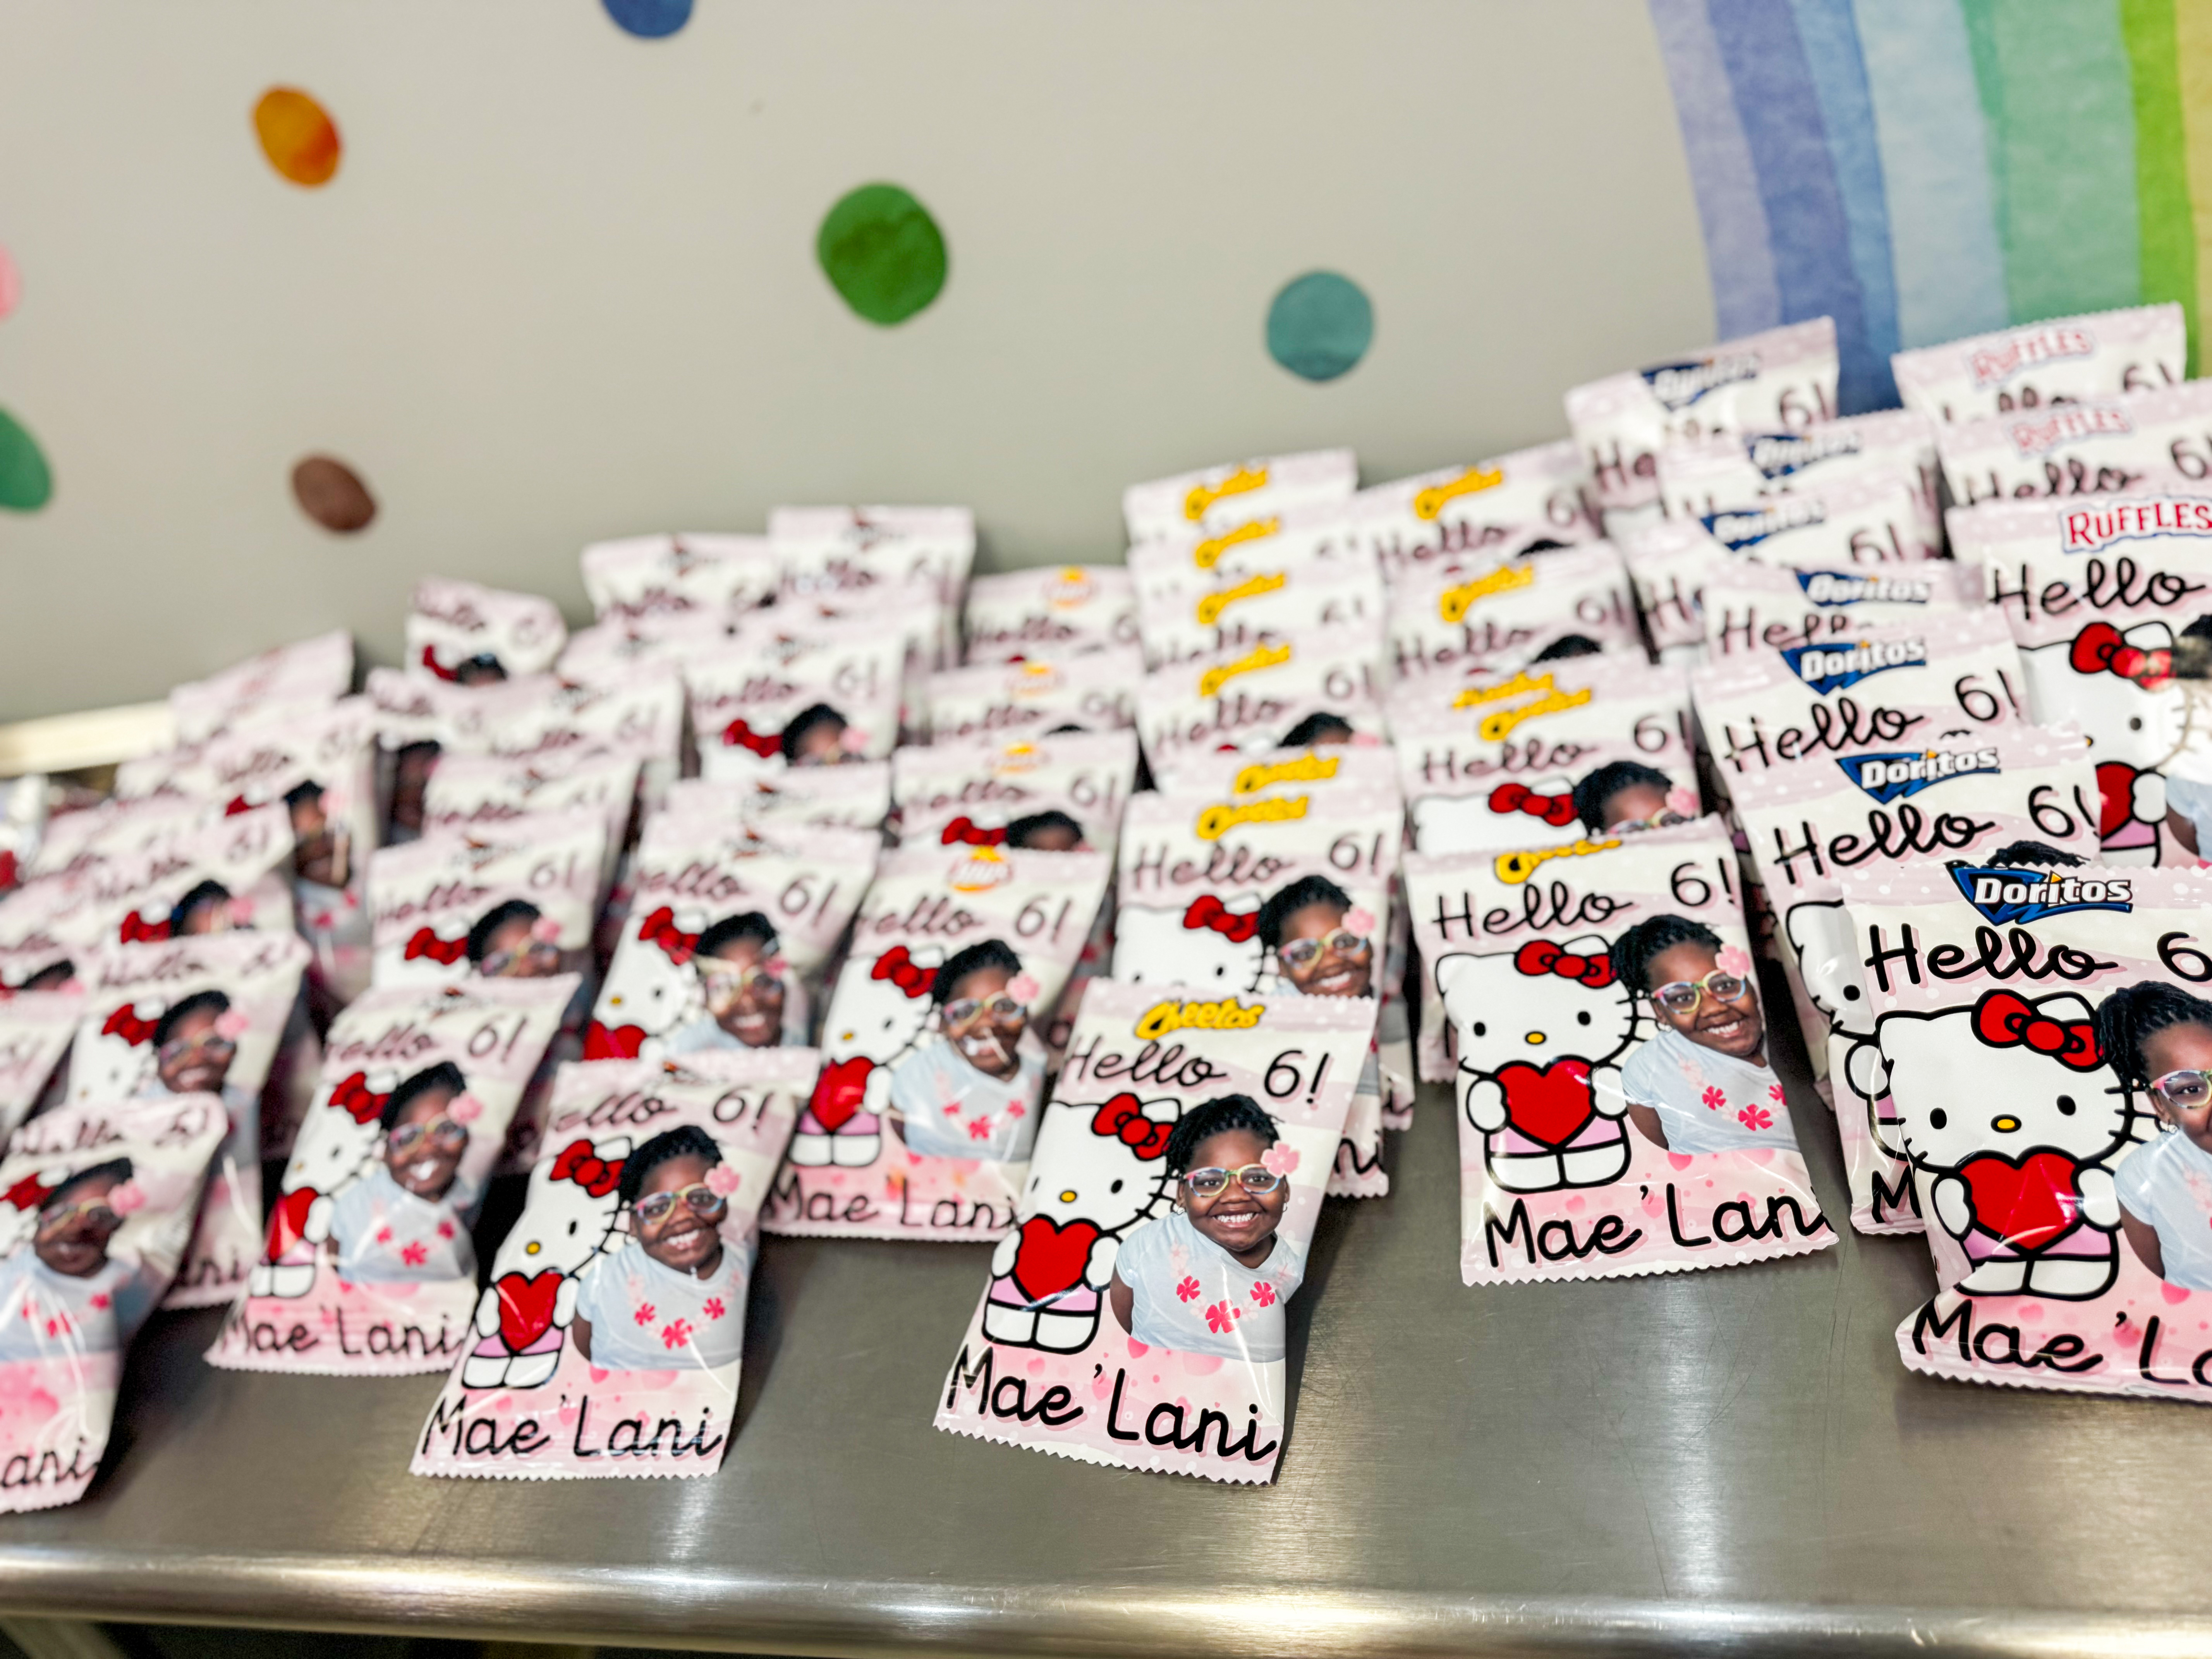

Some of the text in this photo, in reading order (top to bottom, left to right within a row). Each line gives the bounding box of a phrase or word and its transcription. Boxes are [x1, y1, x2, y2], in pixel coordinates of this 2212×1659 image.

[2068, 502, 2212, 545] RUFFLES
[1988, 557, 2207, 620] Hello
[1801, 640, 1926, 682] Doritos
[1422, 738, 1599, 781] Hello
[1724, 697, 1924, 773] Hello
[1860, 747, 1999, 790] Doritos
[1134, 841, 1294, 890] Hello
[1773, 785, 2099, 884] Hello 6!
[1432, 881, 1633, 939] Hello
[1671, 857, 1736, 907] 6!
[1974, 871, 2133, 906] Doritos
[1865, 923, 2119, 993] Hello
[1135, 997, 1266, 1041] Cheetos
[1065, 1035, 1329, 1104] Hello 6!
[421, 1394, 723, 1458] Mae'Lani
[946, 1344, 1277, 1462] Mae'Lani
